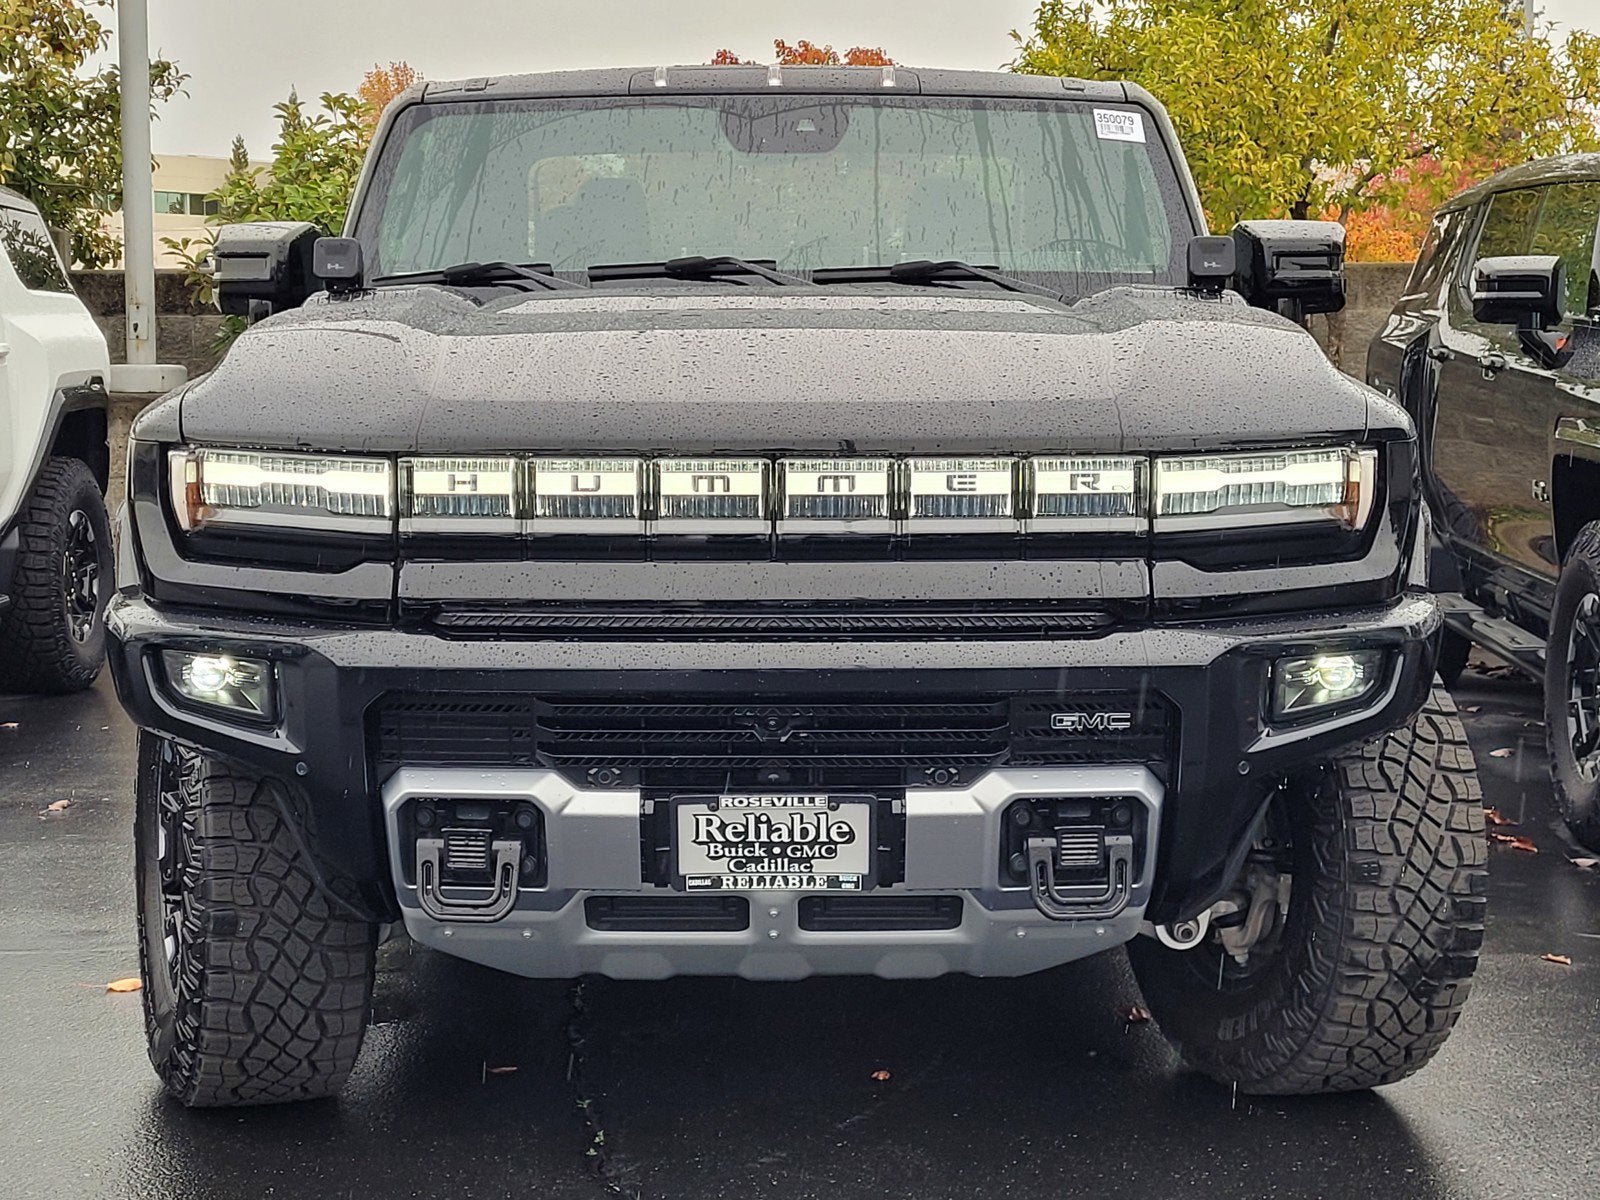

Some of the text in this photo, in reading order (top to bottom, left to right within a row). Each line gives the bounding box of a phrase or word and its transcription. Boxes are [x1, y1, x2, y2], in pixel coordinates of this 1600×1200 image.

[1096, 112, 1135, 126] 350079
[1051, 713, 1131, 730] GMC
[720, 797, 827, 808] ROSEVILLE
[693, 812, 853, 844] Reliable
[708, 843, 837, 859] Buick GMC
[728, 858, 813, 873] Cadillac
[720, 875, 828, 889] RELIABLE
